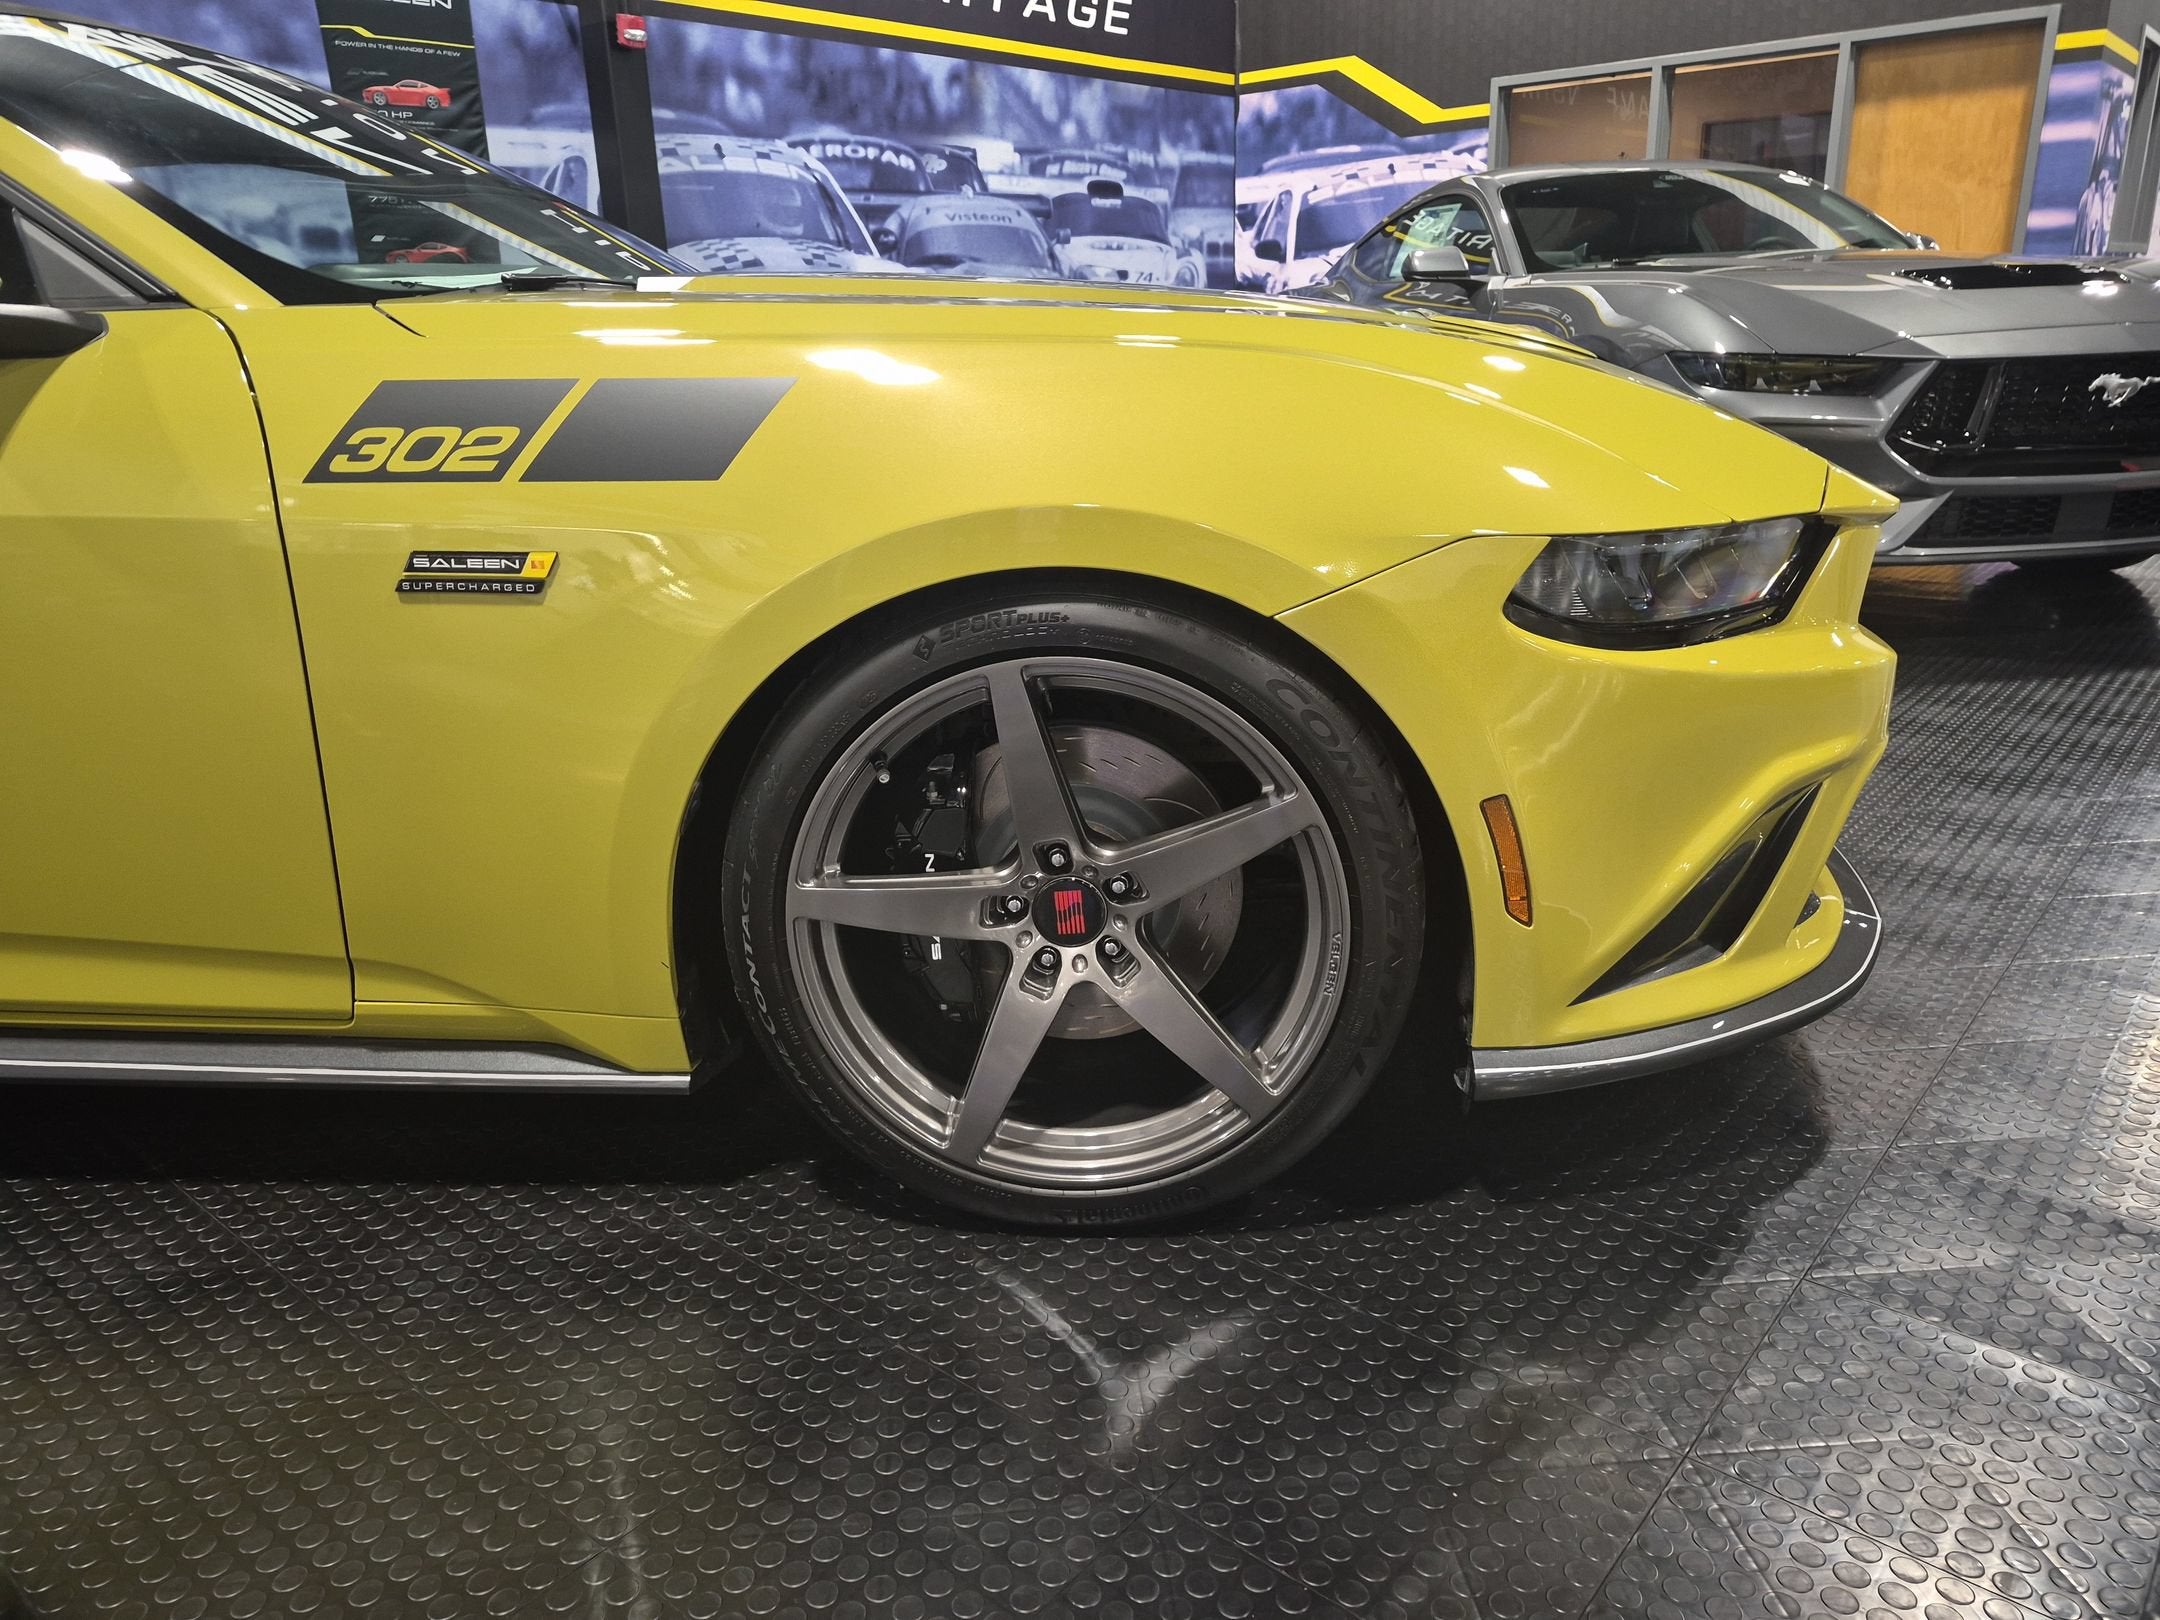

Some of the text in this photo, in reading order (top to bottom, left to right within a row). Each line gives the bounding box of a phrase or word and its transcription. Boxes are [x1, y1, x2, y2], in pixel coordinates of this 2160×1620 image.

[942, 0, 1134, 36] AGE
[334, 40, 368, 49] POWER
[378, 43, 394, 51] THE
[395, 44, 424, 54] HANDS
[391, 111, 413, 119] HP
[944, 210, 1013, 225] Visteon
[329, 426, 521, 473] 302
[412, 557, 520, 569] SALEEN
[402, 582, 536, 593] SUPERCHARGED
